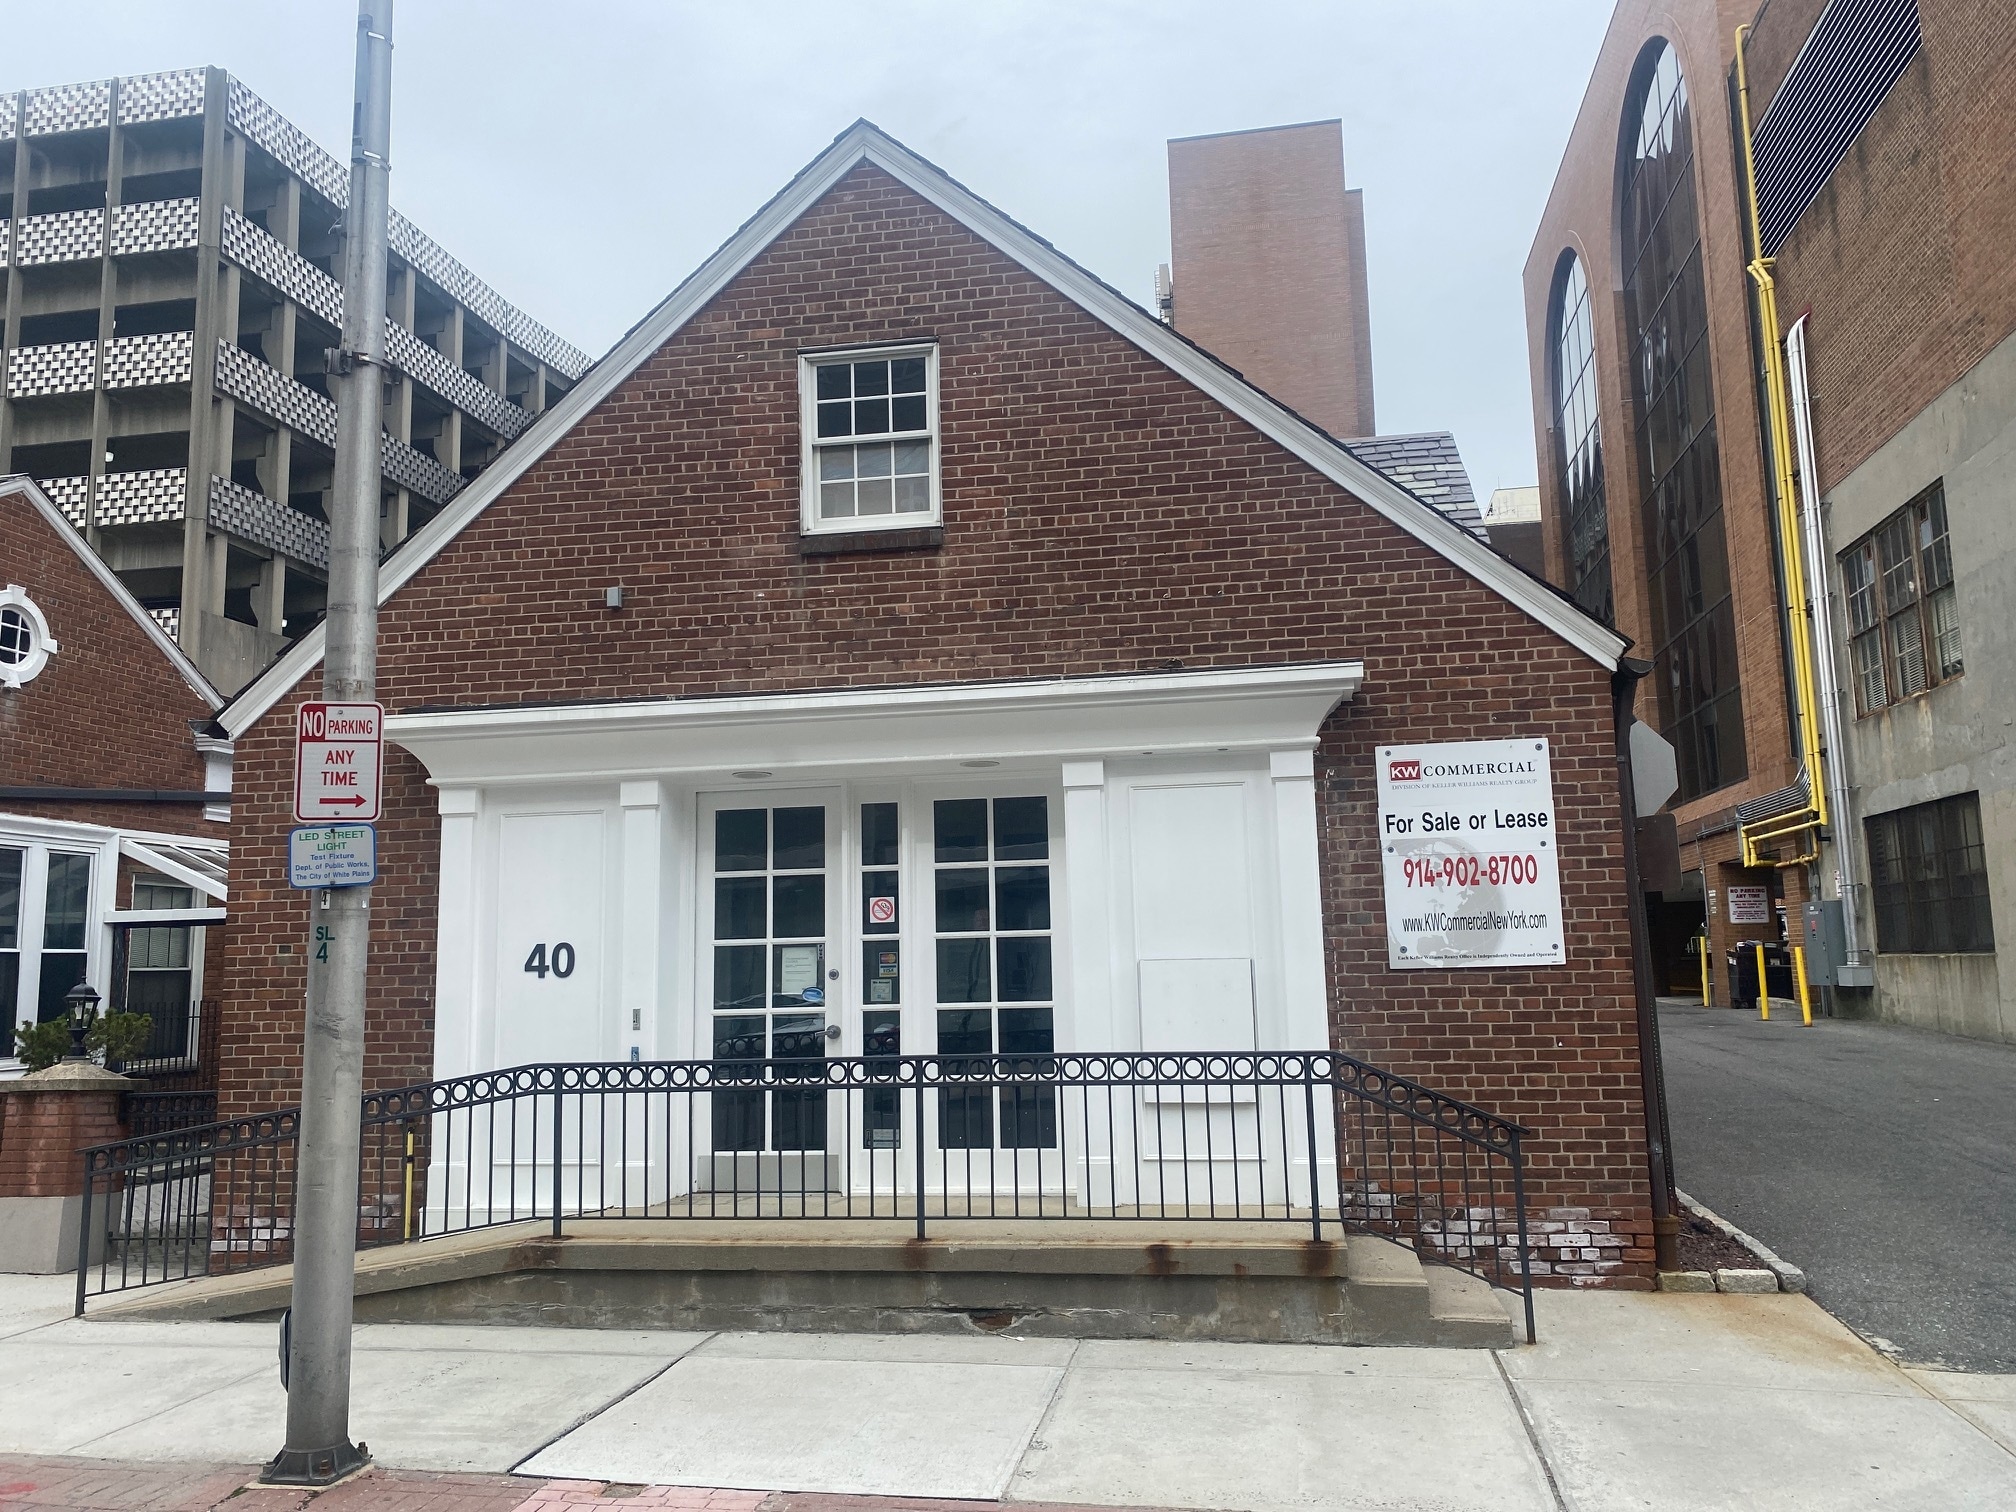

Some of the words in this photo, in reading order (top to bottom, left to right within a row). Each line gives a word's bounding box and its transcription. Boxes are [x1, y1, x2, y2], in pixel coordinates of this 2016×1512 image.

[302, 711, 325, 737] NO
[328, 720, 373, 734] PARKING
[325, 750, 355, 764] ANY
[321, 772, 358, 786] TIME
[1390, 766, 1419, 778] KW
[1423, 761, 1536, 777] COMMERCIAL
[1386, 814, 1414, 834] For
[1422, 812, 1460, 832] Sale
[1469, 815, 1486, 830] or
[1494, 809, 1548, 828] Lease
[298, 832, 320, 841] LED
[324, 830, 366, 840] STREET
[317, 842, 347, 851] LIGHT
[1403, 854, 1538, 888] 914-902-8700
[1402, 910, 1548, 932] www.KWCommercialNewYork.com
[316, 926, 336, 940] SL
[316, 942, 328, 963] 4
[524, 942, 576, 978] 40
